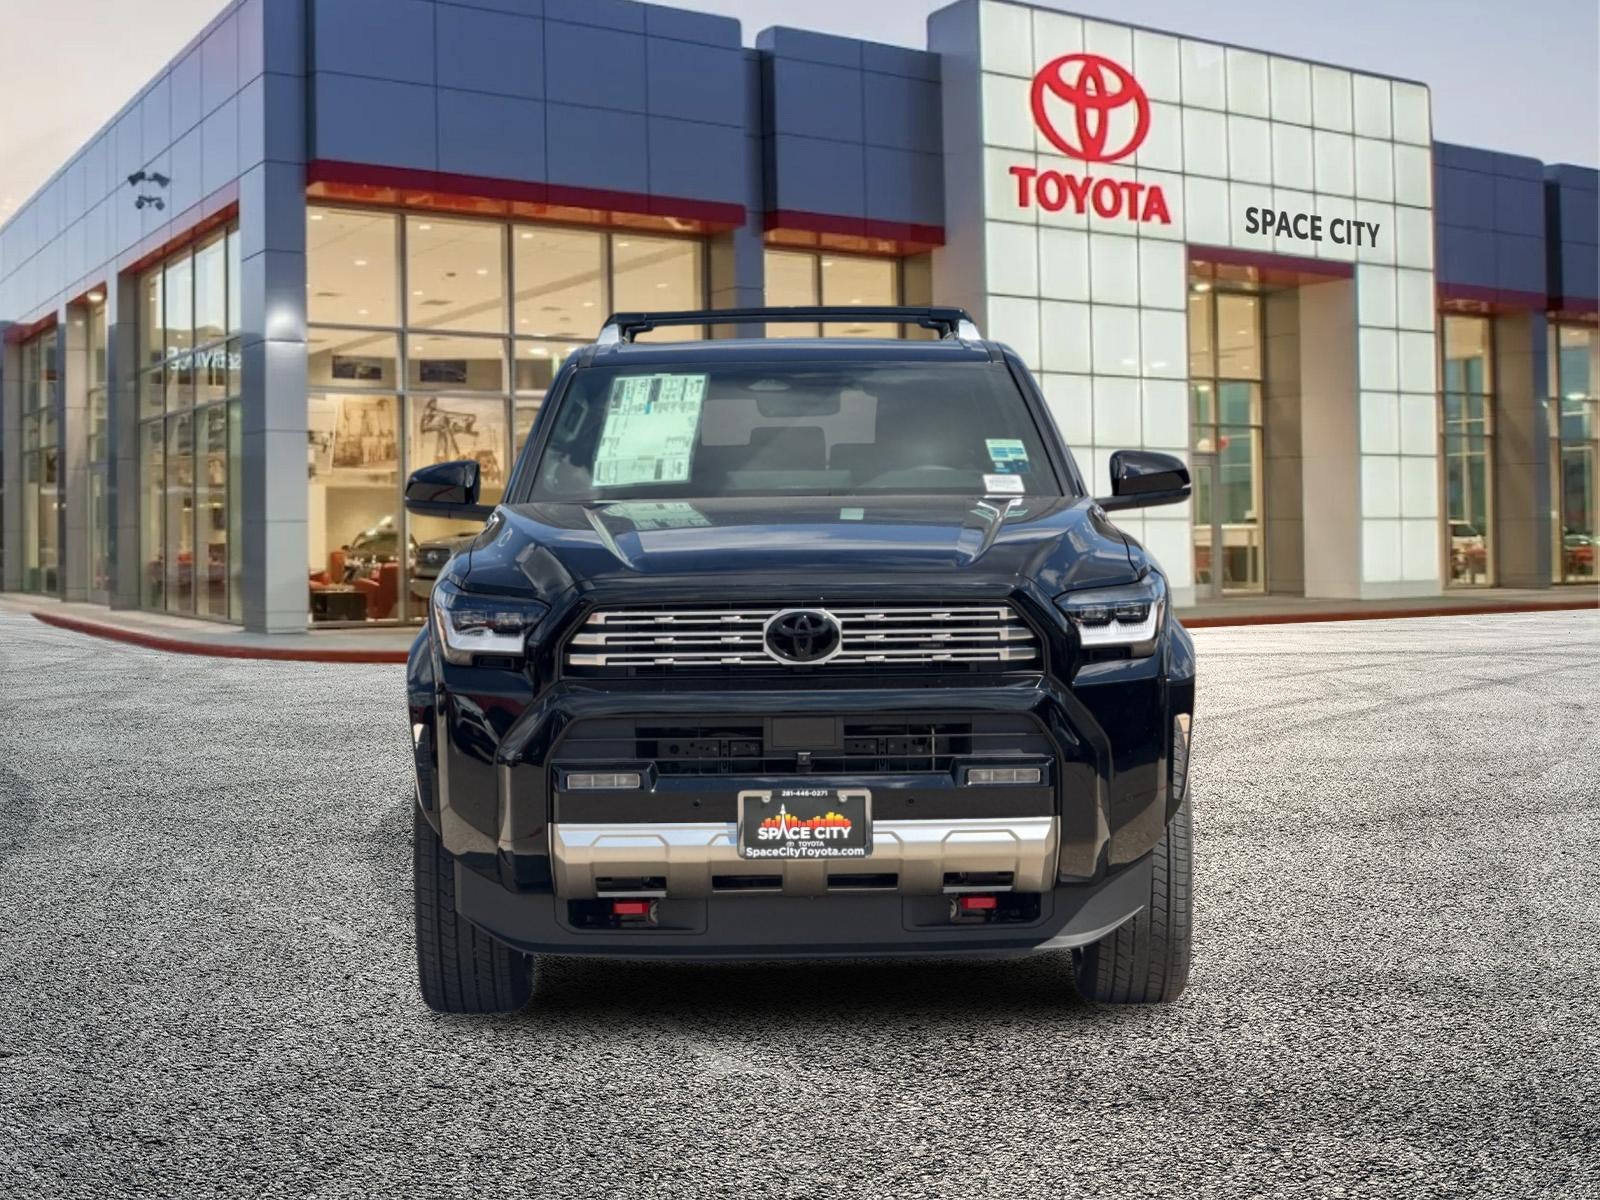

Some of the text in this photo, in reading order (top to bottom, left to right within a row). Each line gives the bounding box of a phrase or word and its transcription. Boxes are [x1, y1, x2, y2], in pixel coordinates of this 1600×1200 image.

[1009, 166, 1171, 225] TOYOTA
[1245, 206, 1380, 248] SPACE CITY
[757, 826, 852, 840] SPACE CITY
[746, 847, 865, 857] SpaceCityToyota.com
